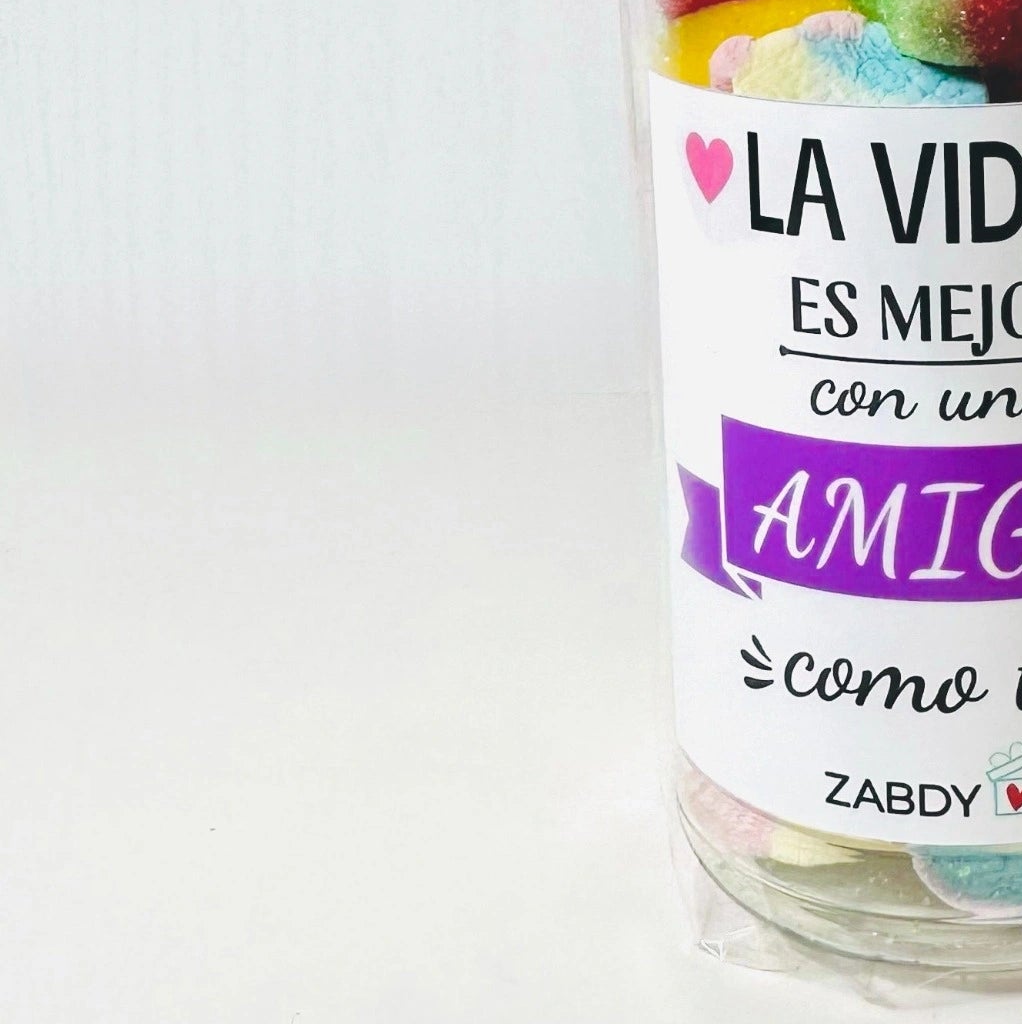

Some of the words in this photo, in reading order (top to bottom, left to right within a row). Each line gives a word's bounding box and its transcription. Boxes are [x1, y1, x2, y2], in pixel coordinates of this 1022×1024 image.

[746, 130, 846, 241] LA
[791, 275, 859, 338] ES
[810, 378, 919, 420] con
[783, 650, 989, 714] como
[824, 771, 982, 818] ZABDY
